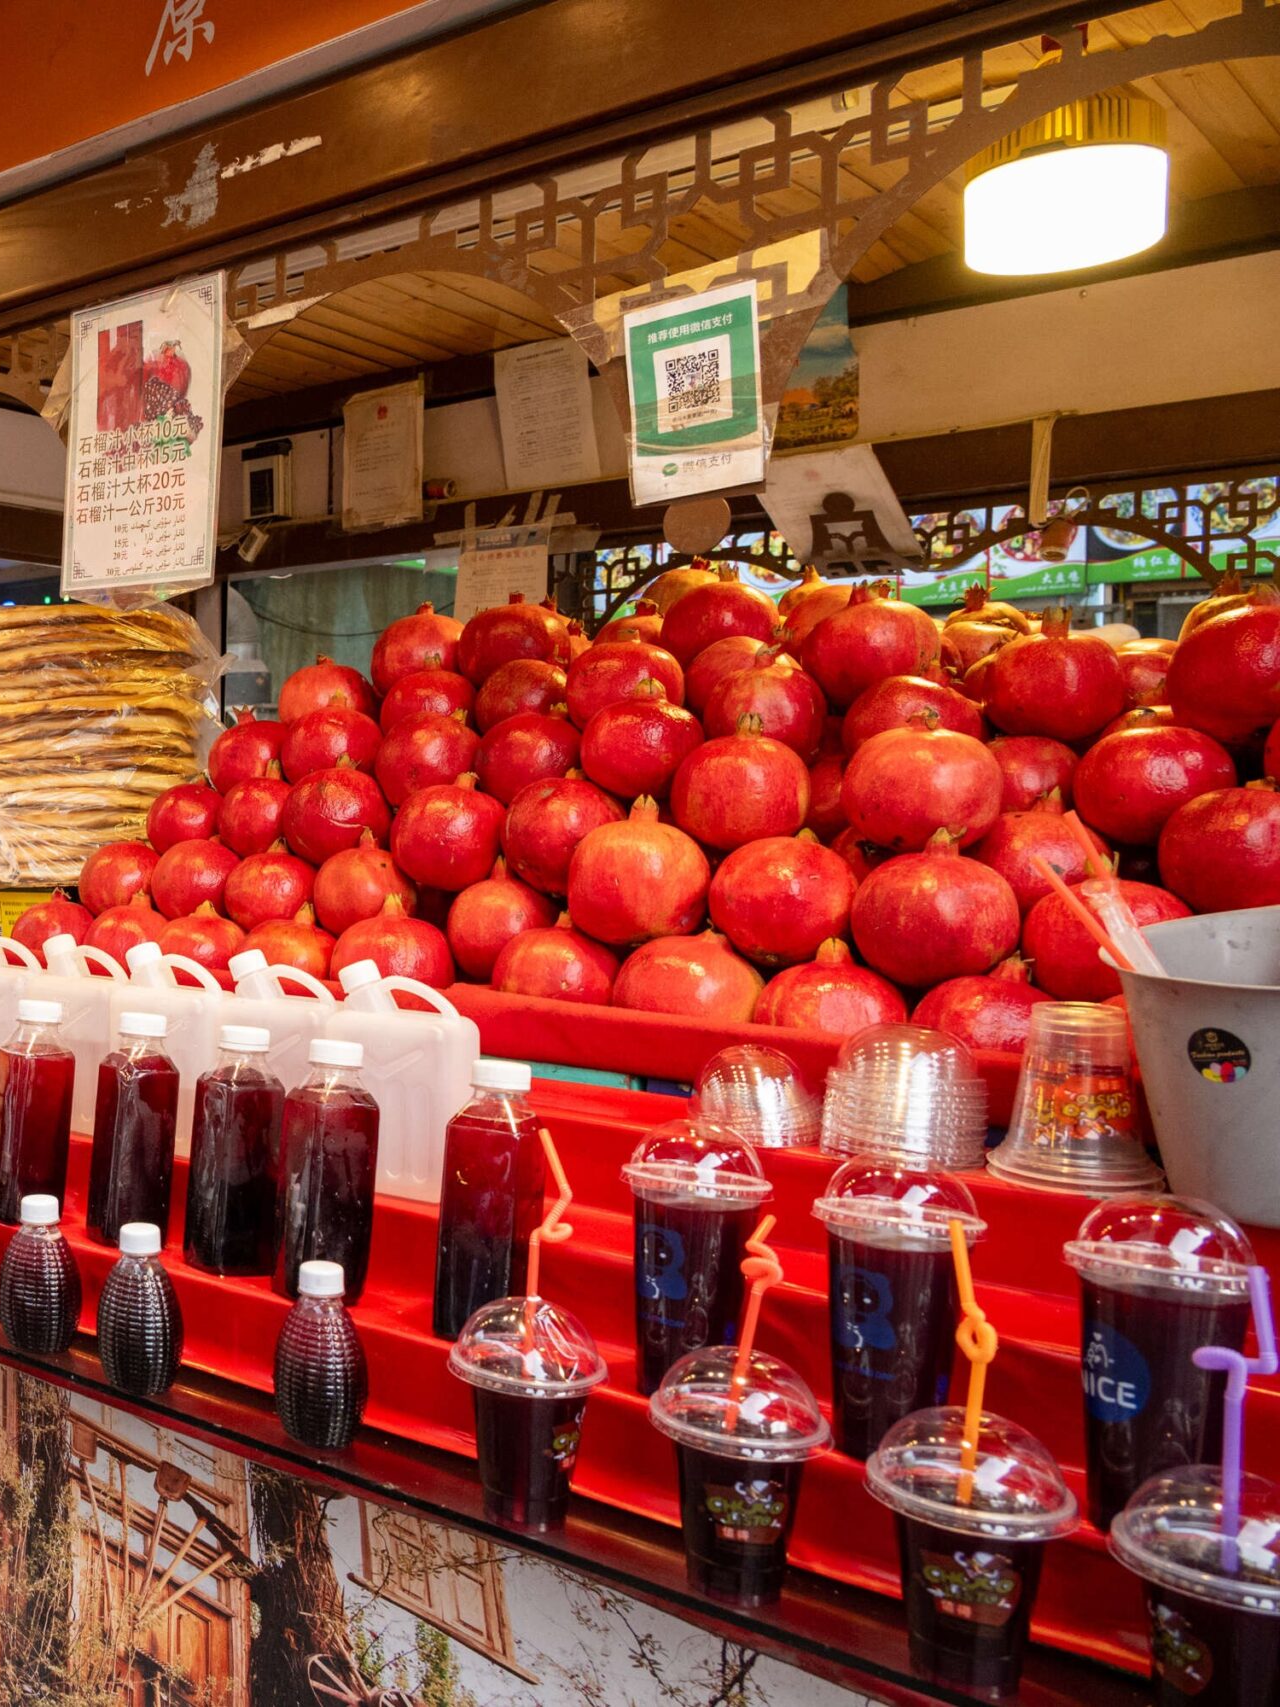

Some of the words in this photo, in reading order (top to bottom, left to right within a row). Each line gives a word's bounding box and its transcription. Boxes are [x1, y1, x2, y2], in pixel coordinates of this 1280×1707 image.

[647, 312, 734, 345] 推荐使用微信支付
[79, 416, 188, 456] 石榴汁小杯10元
[78, 443, 186, 479] 石榴汁中杯15元
[682, 453, 732, 473] 微信支付
[76, 467, 186, 503] 石榴汁大杯20元
[76, 493, 185, 524] 石榴汁一公斤30元
